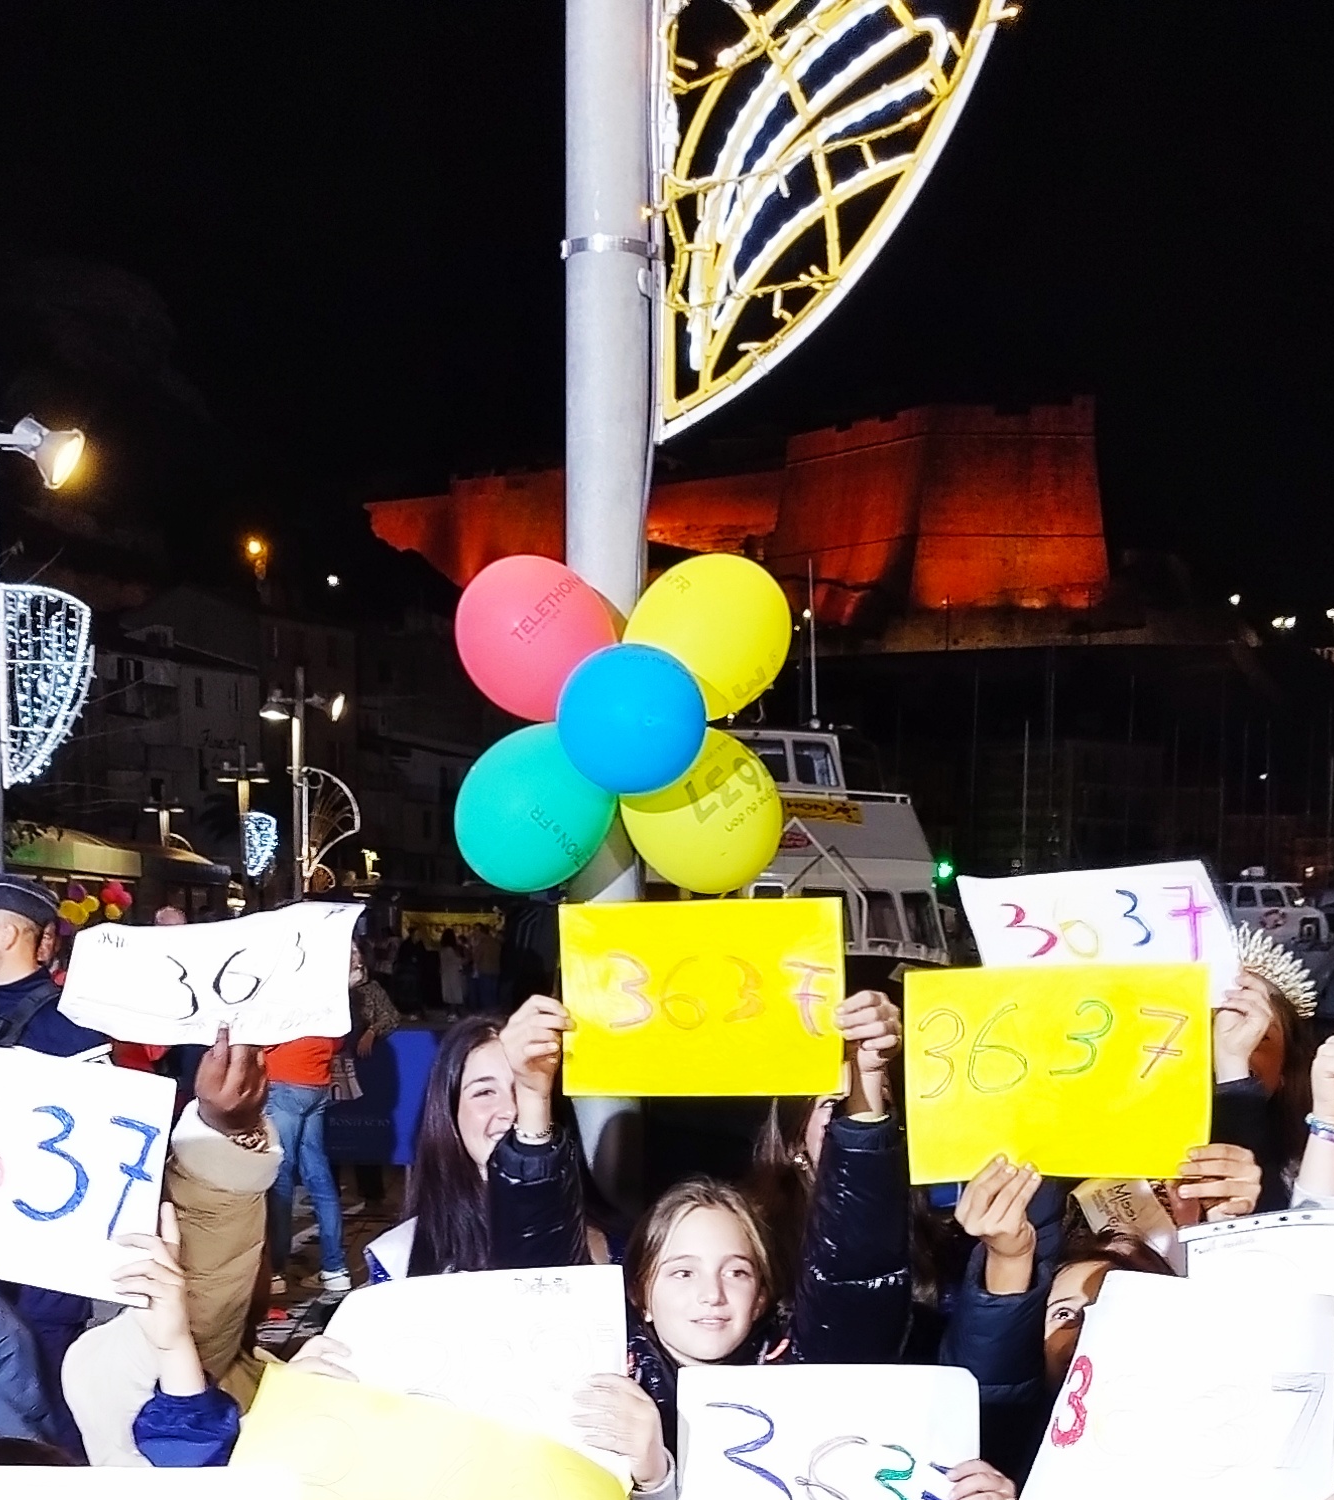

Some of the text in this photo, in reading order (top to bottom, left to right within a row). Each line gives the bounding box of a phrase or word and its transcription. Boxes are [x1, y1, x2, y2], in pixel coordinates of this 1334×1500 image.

[510, 576, 578, 641] TELETHON
[1000, 886, 1213, 961] 3637
[608, 952, 835, 1037] 3637
[917, 1000, 1189, 1099] 3637
